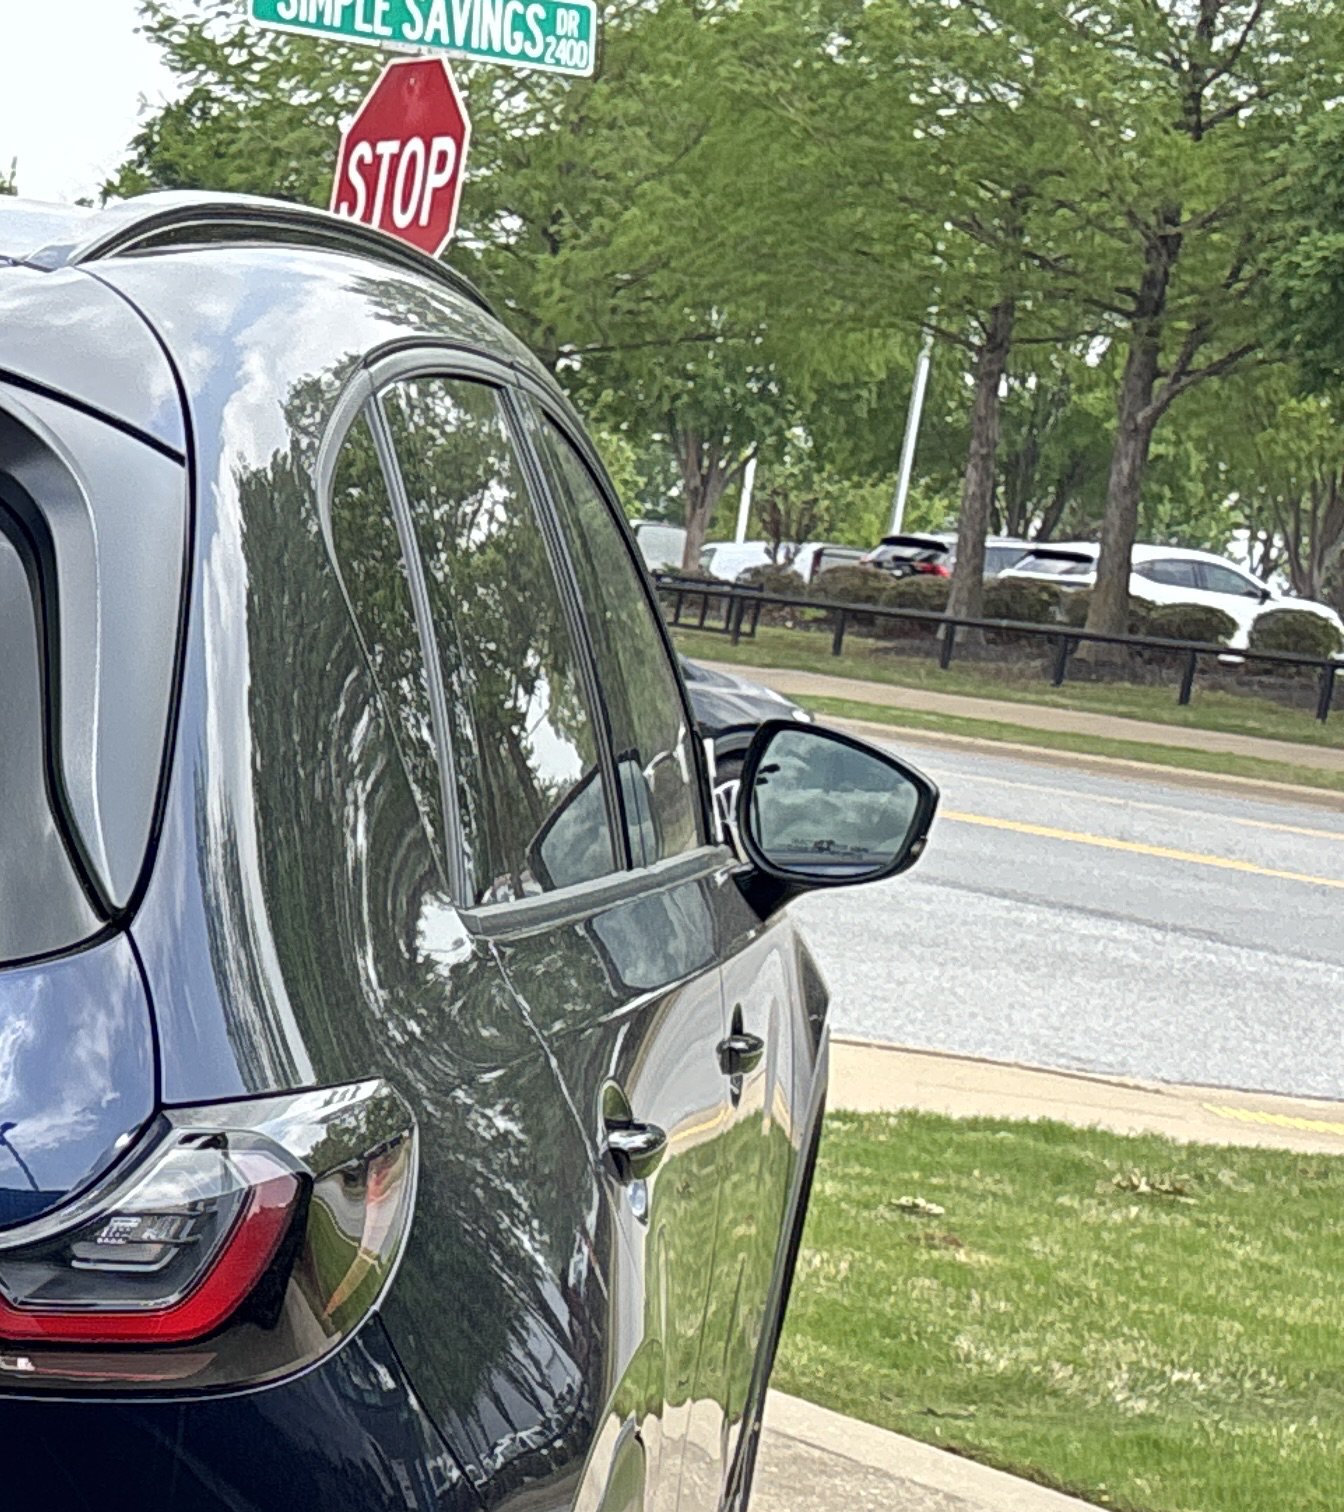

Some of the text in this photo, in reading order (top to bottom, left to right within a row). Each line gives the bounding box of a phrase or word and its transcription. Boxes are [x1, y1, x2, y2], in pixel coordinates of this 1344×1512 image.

[401, 0, 547, 58] SAVINGS
[555, 8, 580, 38] DR
[544, 36, 588, 68] 2400
[340, 136, 456, 229] STOP
